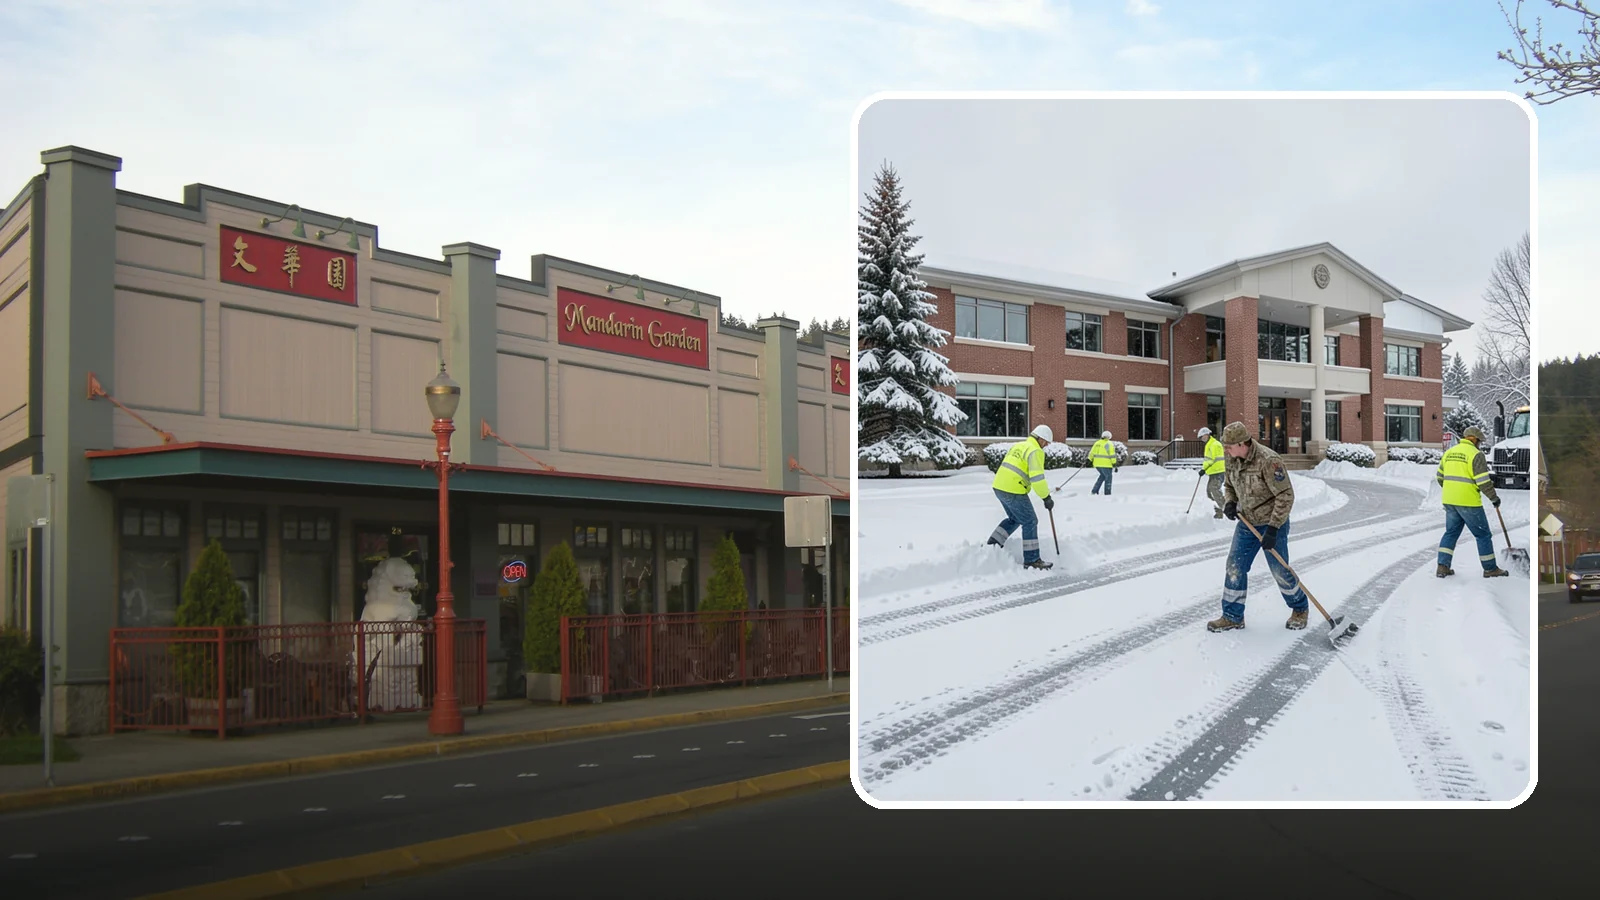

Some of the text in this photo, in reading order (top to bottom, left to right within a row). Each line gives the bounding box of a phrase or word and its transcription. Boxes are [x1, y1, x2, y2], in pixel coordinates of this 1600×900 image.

[231, 236, 346, 291] 文華園
[564, 302, 701, 352] Mandarin Garden
[503, 565, 527, 578] OPEN
